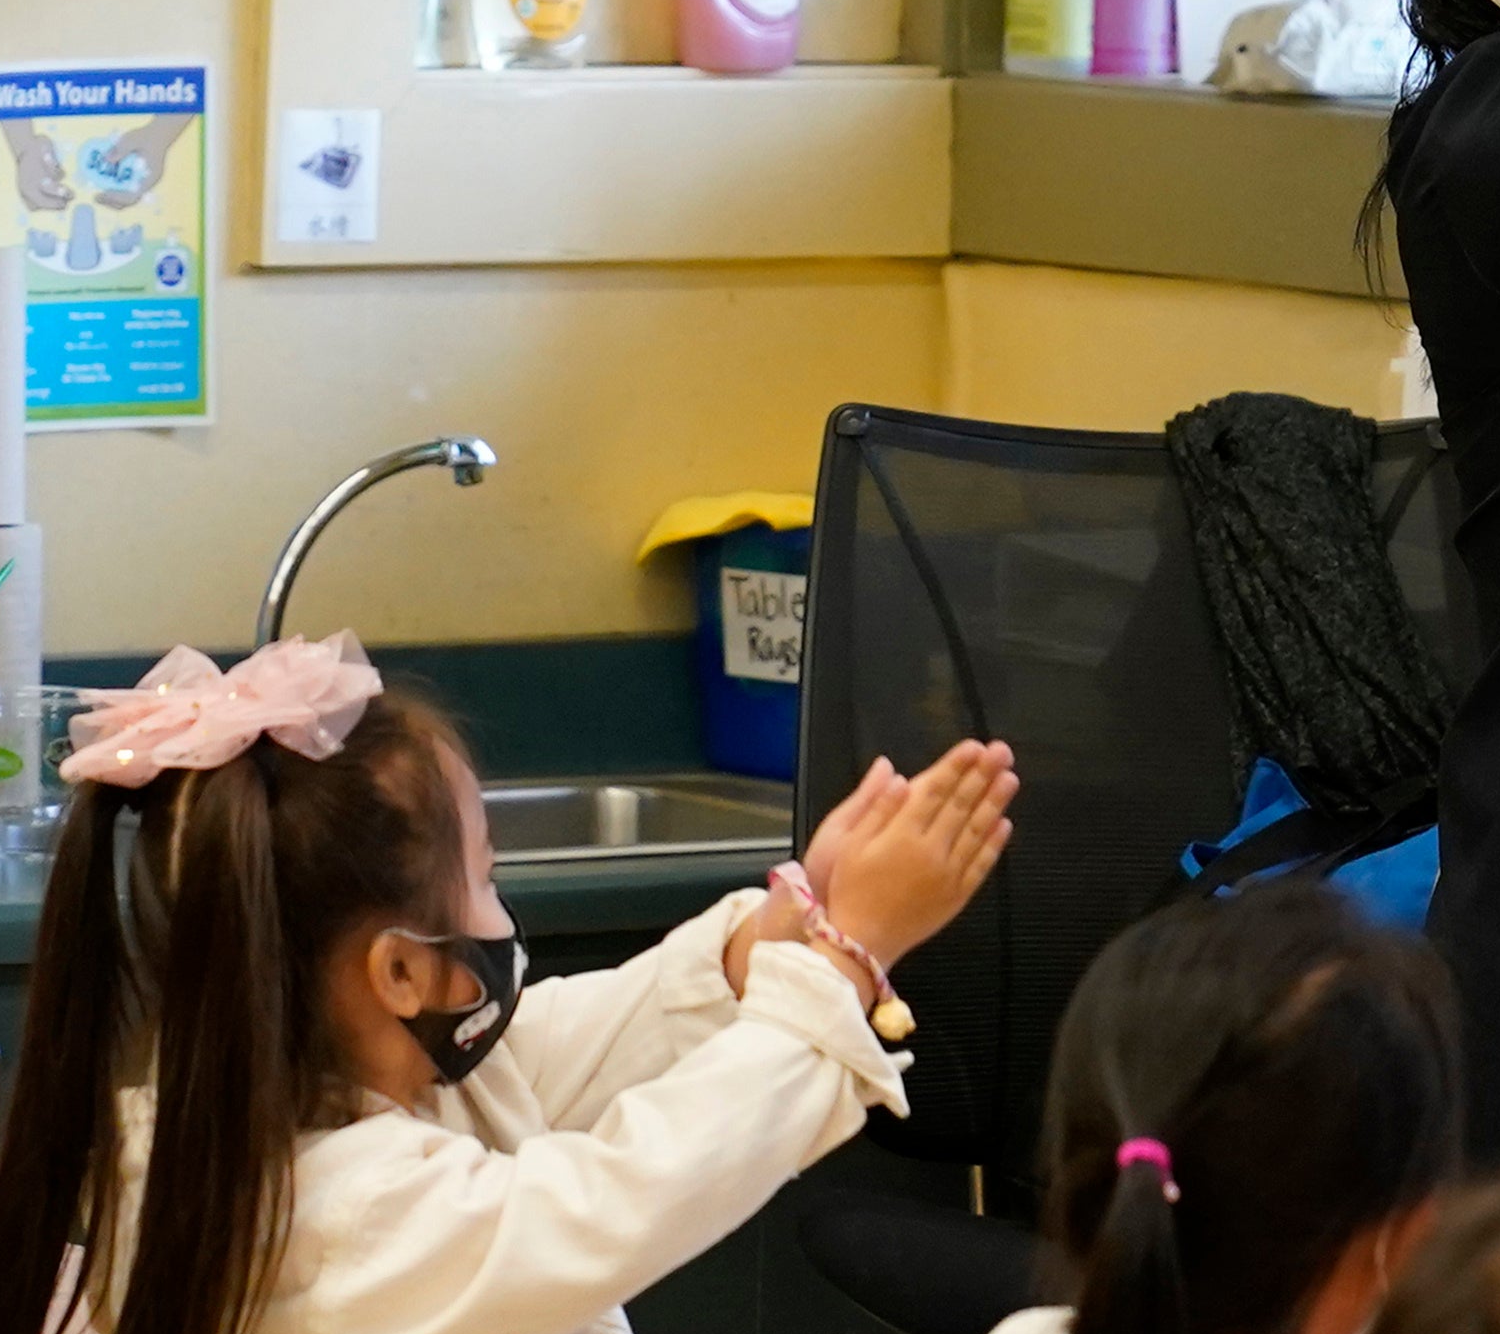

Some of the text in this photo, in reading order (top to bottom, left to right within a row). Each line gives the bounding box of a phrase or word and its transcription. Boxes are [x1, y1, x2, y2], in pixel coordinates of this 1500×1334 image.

[56, 82, 111, 106] Your
[115, 78, 196, 103] Hands
[728, 576, 804, 624] Table
